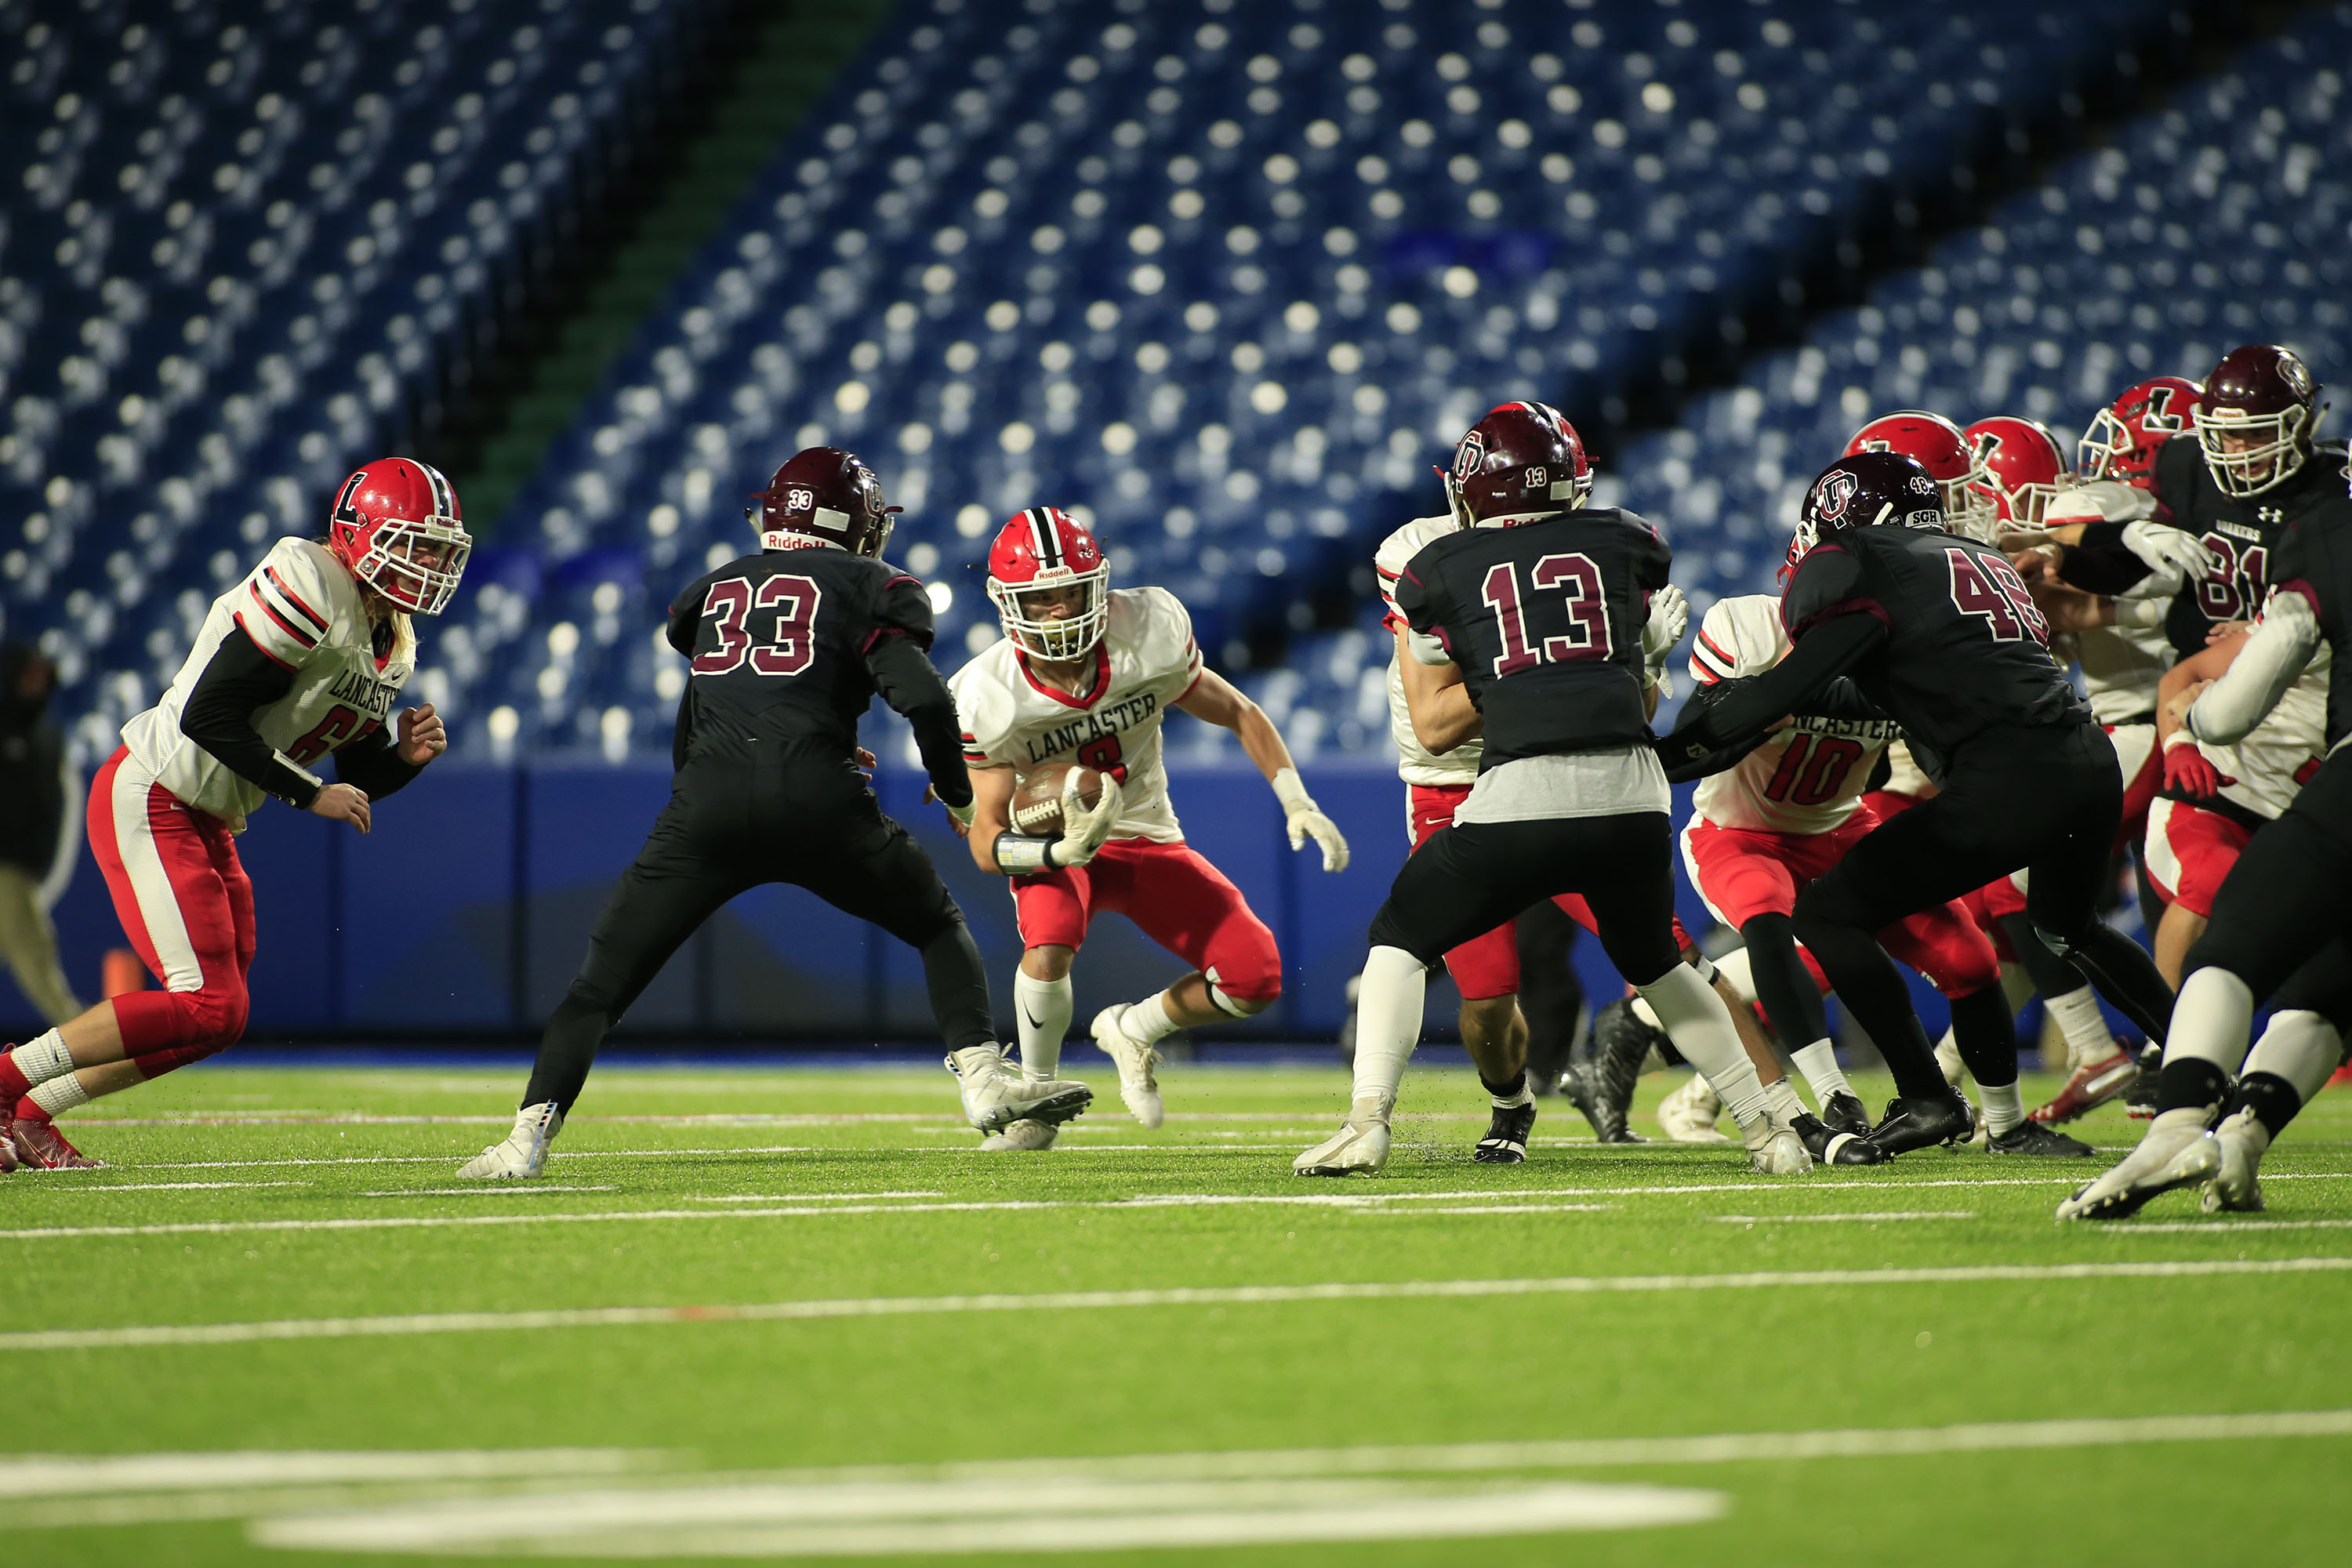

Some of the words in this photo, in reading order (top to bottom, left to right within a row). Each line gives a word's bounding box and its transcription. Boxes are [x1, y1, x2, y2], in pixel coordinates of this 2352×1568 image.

[2142, 387, 2183, 432] L
[335, 471, 368, 526] L
[788, 489, 813, 510] 33
[1526, 466, 1547, 488] 13
[1910, 476, 1930, 495] 48
[1912, 510, 1937, 524] SGH
[1039, 568, 1069, 579] Riddell
[2194, 531, 2268, 621] 81
[1481, 552, 1613, 680] 13
[1944, 547, 2050, 651] 48
[690, 574, 822, 677] 33
[328, 669, 401, 715] LANCASTE
[1026, 692, 1156, 764] LANCASTER
[1791, 715, 1900, 740] NCASTER
[1077, 731, 1128, 788] 8
[1763, 731, 1864, 805] 10
